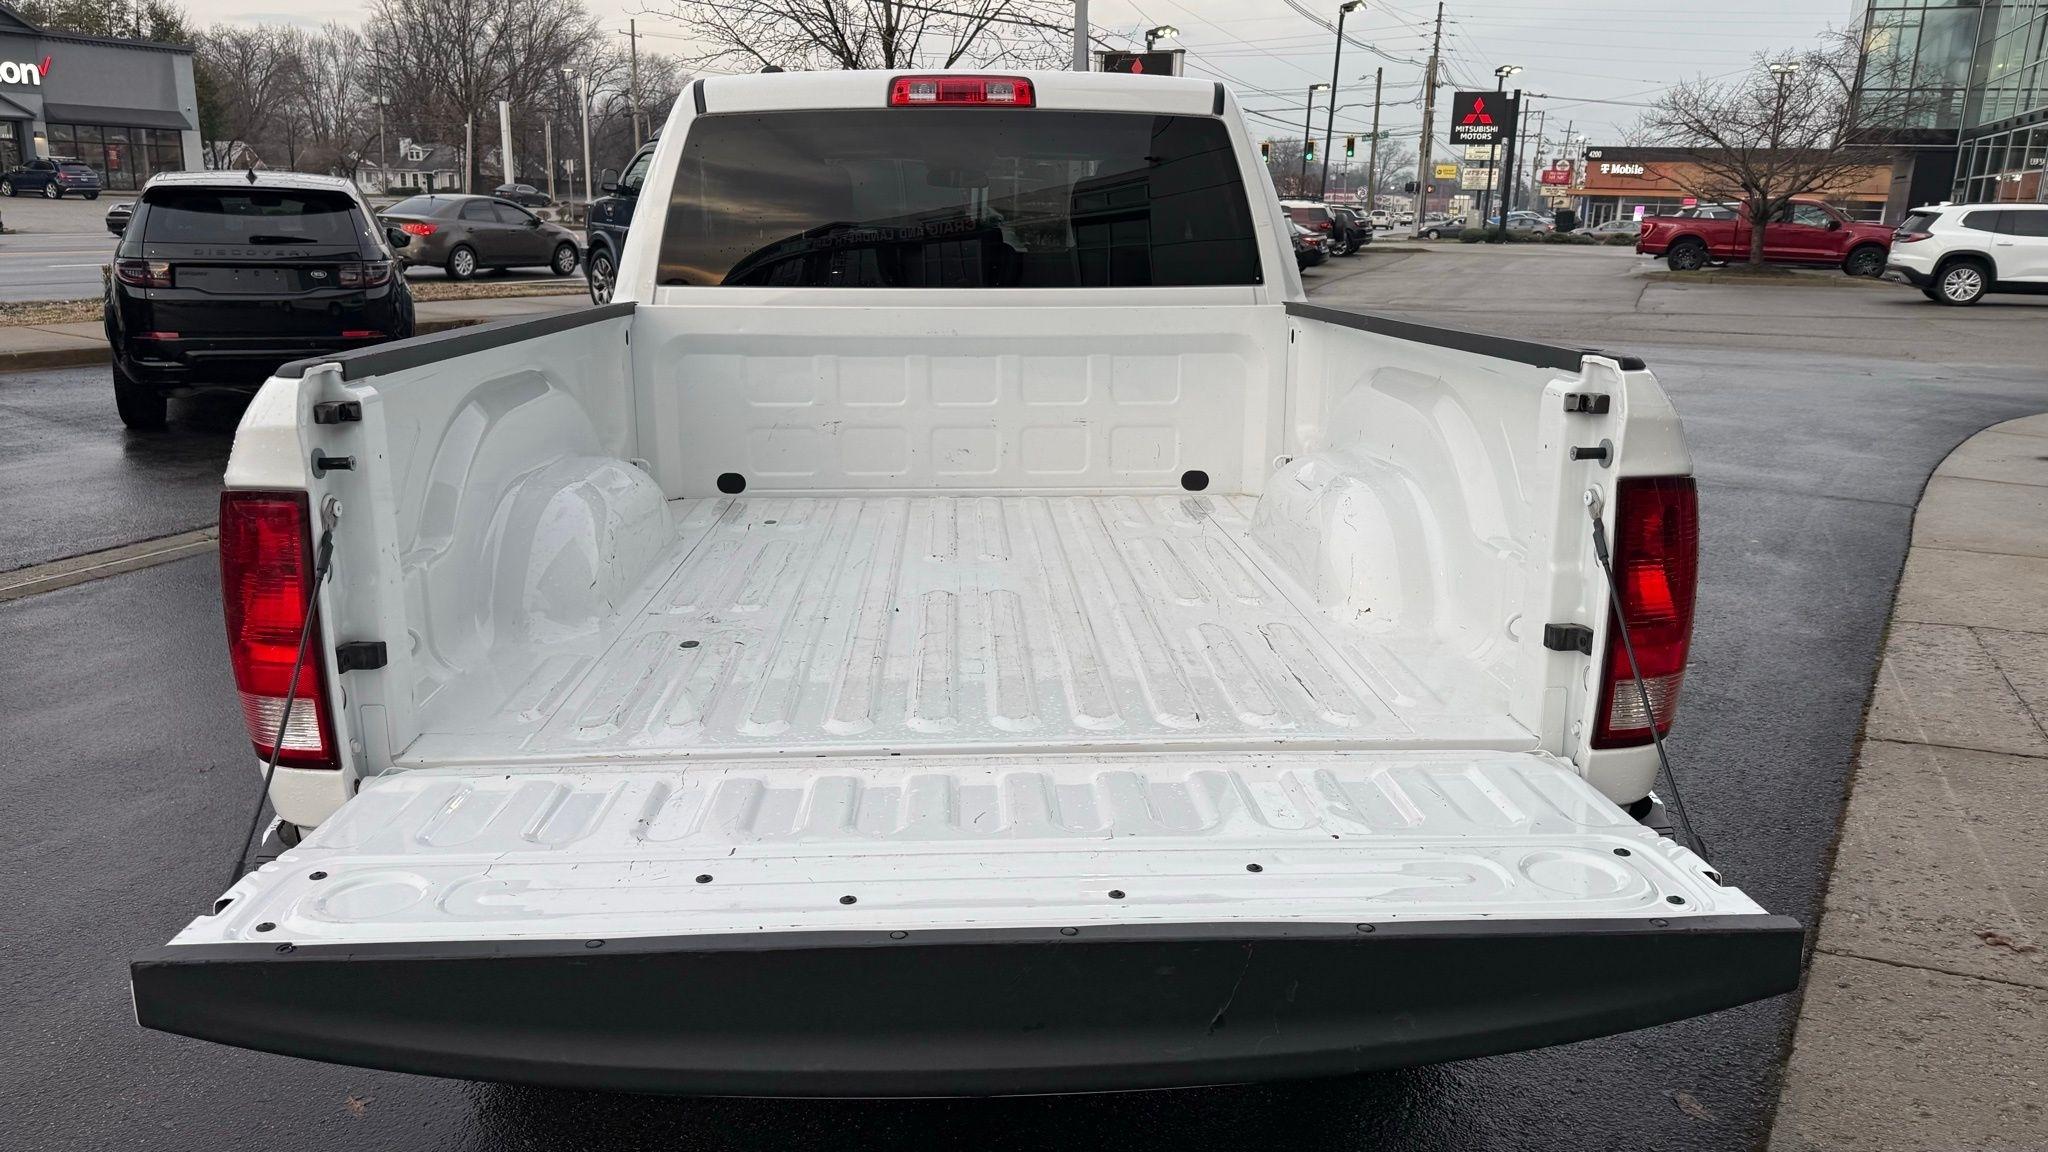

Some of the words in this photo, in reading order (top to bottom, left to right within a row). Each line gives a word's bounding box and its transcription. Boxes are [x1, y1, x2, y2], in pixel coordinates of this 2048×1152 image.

[0, 61, 41, 86] on
[1455, 125, 1499, 133] MITSUBISHI
[1588, 150, 1603, 159] 4200
[1611, 163, 1644, 175] Mobile
[193, 249, 313, 257] DISCOVERY
